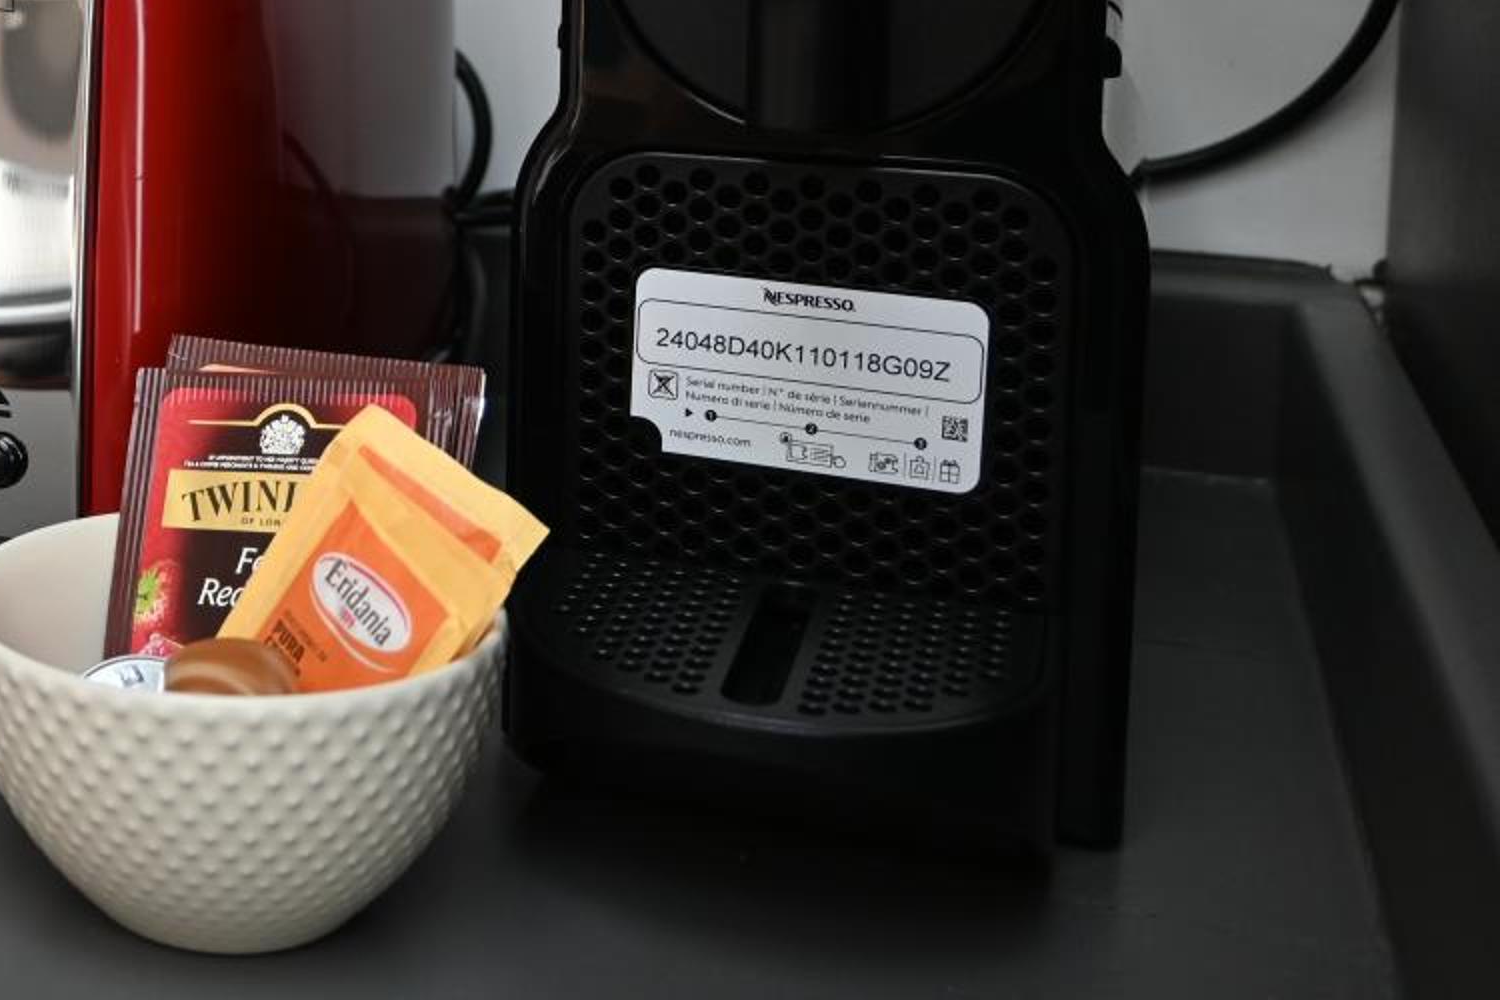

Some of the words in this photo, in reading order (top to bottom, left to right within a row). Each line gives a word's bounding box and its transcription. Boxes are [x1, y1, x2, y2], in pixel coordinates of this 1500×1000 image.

[763, 287, 856, 312] NESPRESSO
[656, 327, 951, 383] 24048D40K110118G09Z
[686, 375, 715, 389] Serial
[717, 382, 760, 395] number
[788, 390, 801, 400] de
[685, 390, 729, 405] Numero
[731, 396, 743, 408] di
[745, 399, 771, 411] serie
[826, 409, 841, 420] de
[844, 411, 871, 424] serie
[669, 428, 752, 448] nespresso.com
[181, 479, 299, 522] TWINI
[241, 516, 254, 526] OF
[259, 518, 281, 527] LON
[325, 558, 392, 647] Eridania
